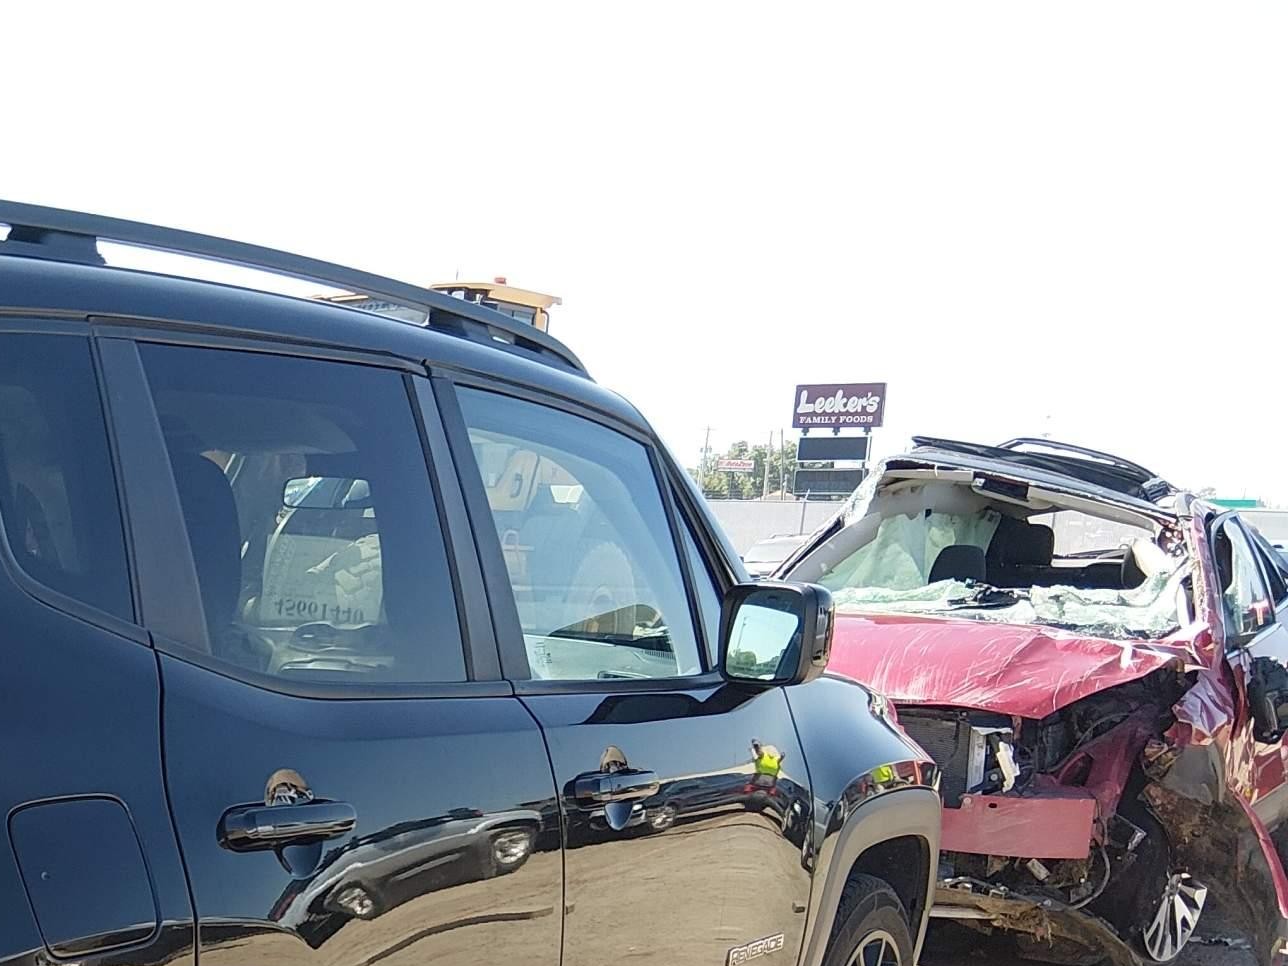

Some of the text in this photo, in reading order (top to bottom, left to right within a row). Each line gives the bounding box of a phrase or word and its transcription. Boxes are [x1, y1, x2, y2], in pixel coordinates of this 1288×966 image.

[796, 389, 881, 414] Leeker's
[799, 415, 874, 424] FAMILY FOODS
